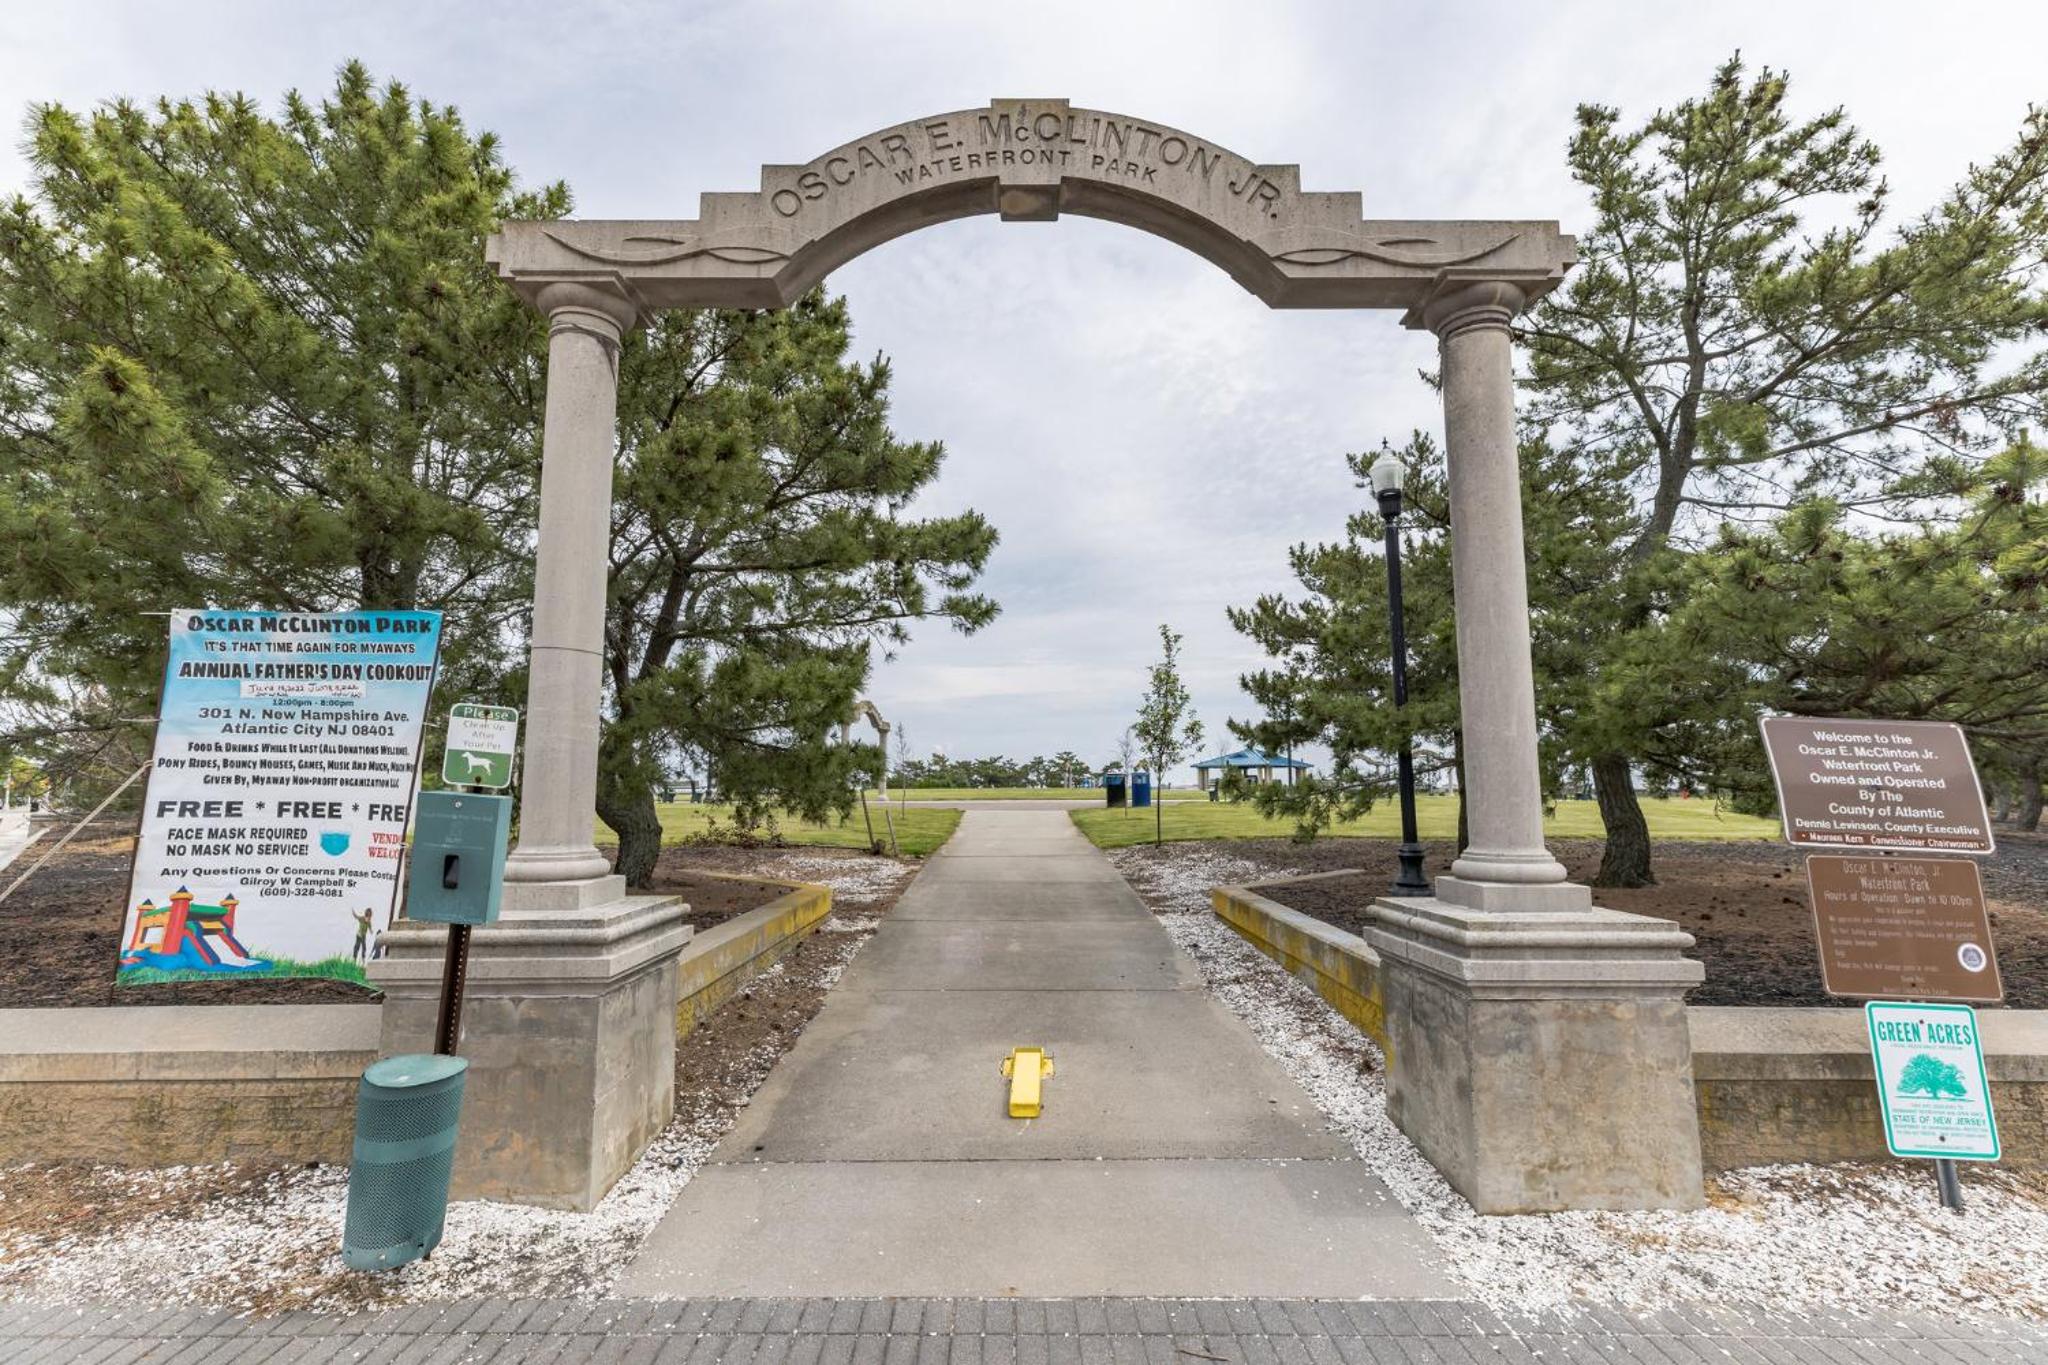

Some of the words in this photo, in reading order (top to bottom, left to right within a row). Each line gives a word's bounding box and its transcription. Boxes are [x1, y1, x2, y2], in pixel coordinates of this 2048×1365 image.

[771, 134, 913, 217] OSCAR
[925, 121, 964, 151] E.
[1228, 172, 1281, 219] JR.
[894, 149, 1071, 186] WATERFRONT
[1091, 154, 1158, 183] PARK
[187, 615, 254, 633] OSCAR
[375, 617, 431, 633] PARK
[204, 641, 227, 652] IT'S
[231, 642, 262, 652] THAT
[265, 642, 293, 653] TIME
[296, 642, 331, 653] AGAIN
[336, 643, 357, 653] FOR
[361, 643, 416, 654] MYAWAYS
[179, 661, 252, 678] ANNUAL
[255, 663, 328, 680] FATHER'S
[331, 664, 363, 681] DAY
[366, 664, 432, 681] COOKOUT
[272, 699, 312, 707] 12:00pm
[320, 699, 355, 708] 8:00pm
[198, 707, 232, 719] 301
[239, 708, 256, 719] N.
[262, 709, 296, 720] New
[301, 709, 379, 722] Hampshire
[384, 710, 409, 722] Ave.
[464, 706, 509, 720] Please
[221, 722, 288, 734] Atlantic
[293, 723, 323, 737] City
[328, 724, 347, 735] NJ
[352, 725, 394, 736] 08401
[1813, 731, 1872, 744] Welcome
[1873, 733, 1889, 744] to
[1891, 734, 1913, 745] the
[1798, 743, 1837, 755] Oscar
[1839, 745, 1853, 756] E.
[1854, 746, 1920, 759] McClinton
[1921, 749, 1939, 760] Jr.
[1822, 759, 1892, 772] Waterfront
[1893, 761, 1923, 773] Park
[1809, 772, 1856, 785] Owned
[1858, 775, 1883, 786] and
[1884, 775, 1946, 789] Operated
[1858, 789, 1876, 802] By
[1880, 790, 1904, 802] The
[156, 800, 244, 818] FREE
[277, 801, 343, 819] FREE
[1828, 802, 1875, 818] County
[1878, 806, 1891, 816] of
[1895, 806, 1945, 819] Atlantic
[167, 828, 204, 840] FACE
[207, 827, 246, 840] MASK
[250, 828, 308, 841] REQUIRED
[1795, 818, 1831, 829] Dennis
[1884, 821, 1923, 834] County
[1926, 823, 1980, 835] Executive
[166, 844, 187, 856] NO
[190, 843, 231, 856] MASK
[235, 844, 254, 855] NO
[256, 843, 309, 856] SERVICE!
[160, 867, 188, 878] Any
[192, 866, 262, 876] Questions
[265, 866, 280, 875] Or
[283, 866, 336, 875] Concerns
[338, 868, 369, 878] Please
[240, 876, 278, 887] Gilroy
[280, 877, 291, 886] W
[294, 877, 344, 888] Campbell
[347, 880, 358, 888] Sr
[1878, 1021, 1921, 1042] GREEN
[1927, 1023, 1972, 1046] ACRES
